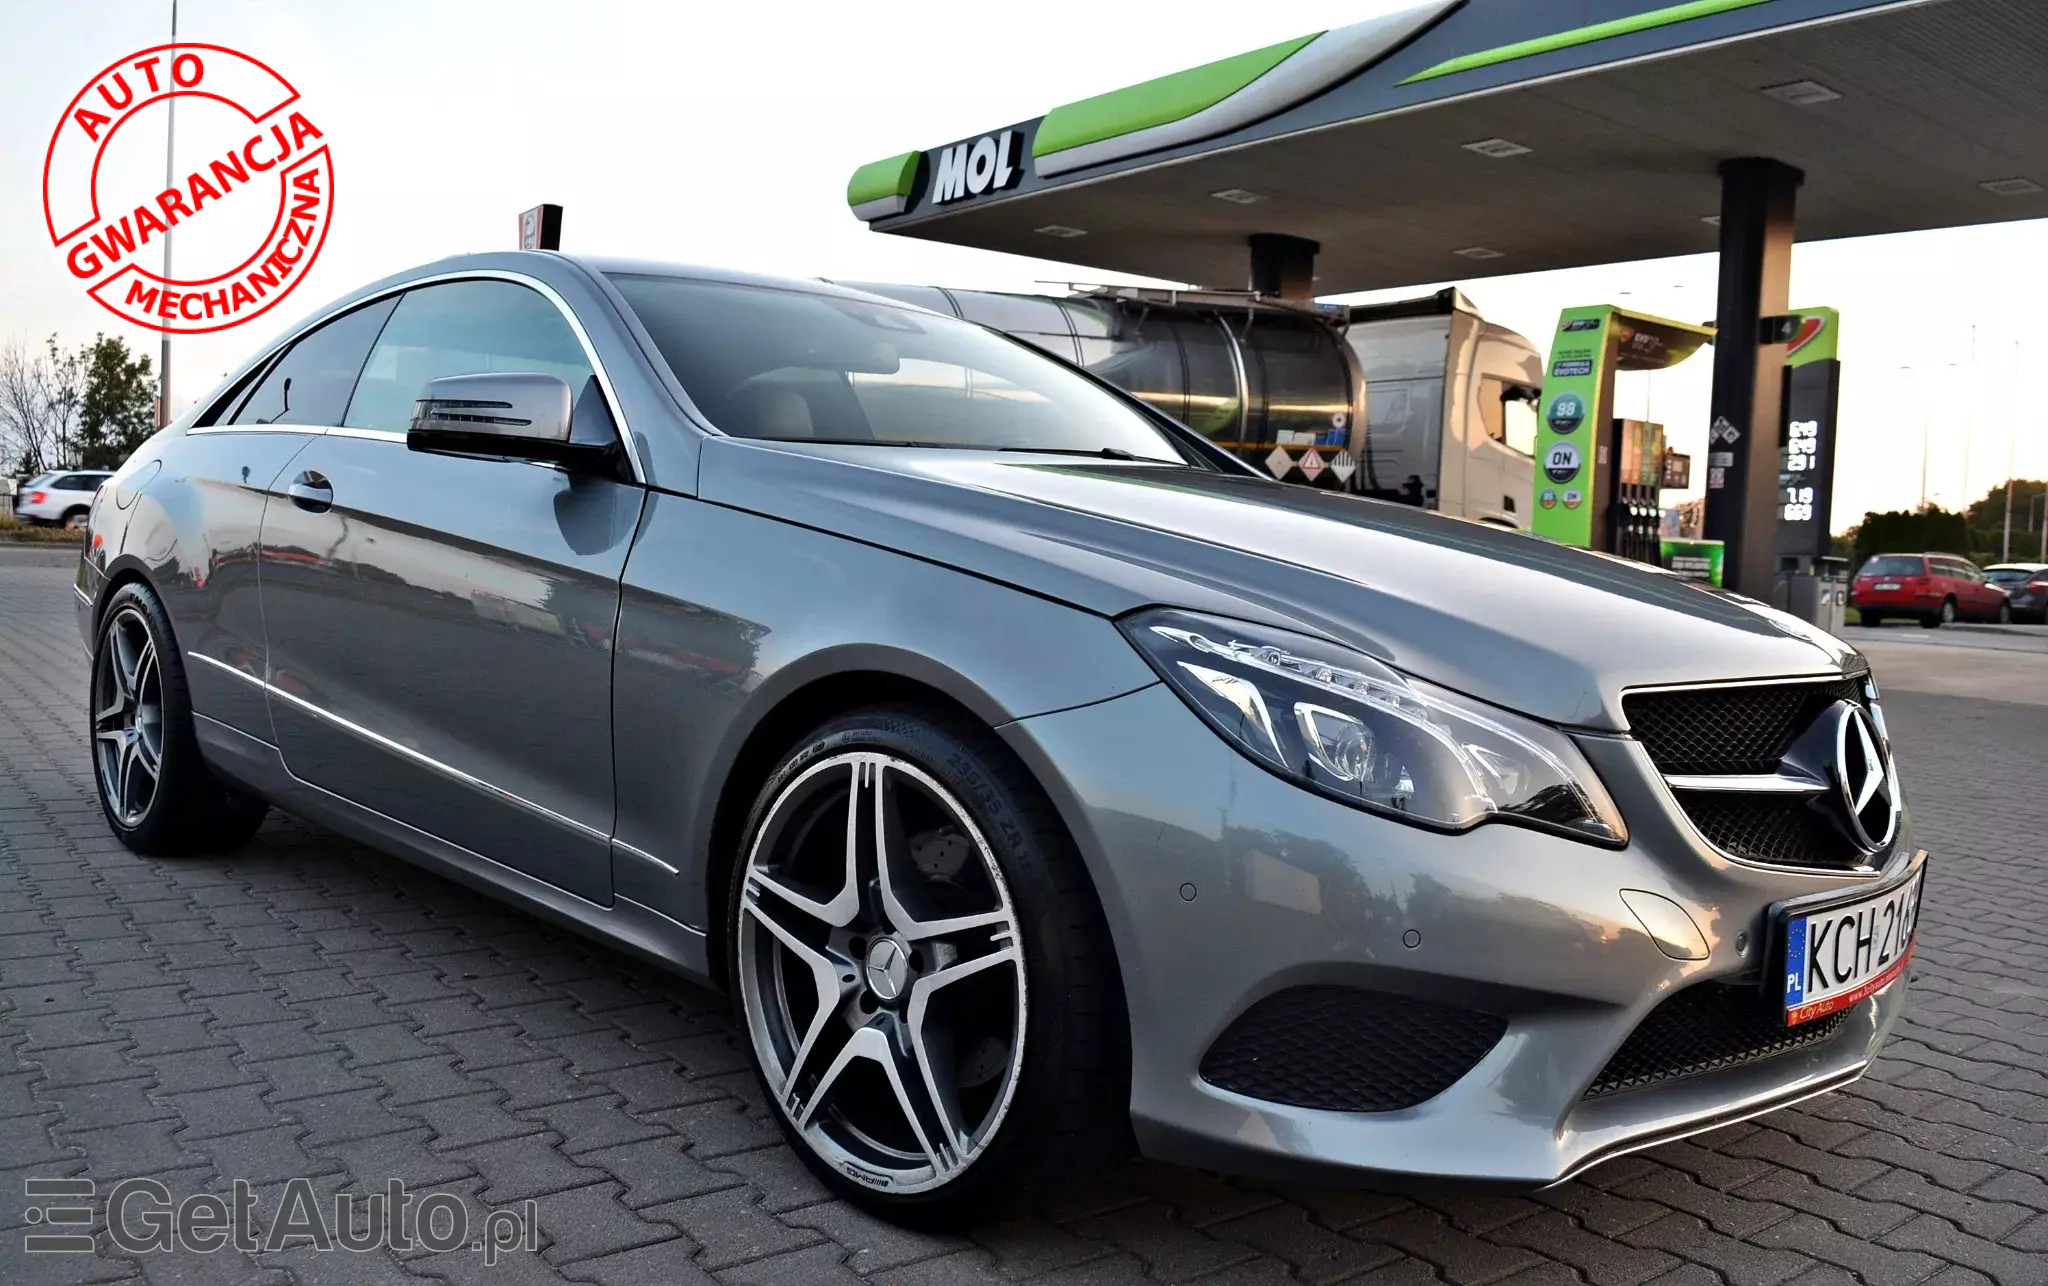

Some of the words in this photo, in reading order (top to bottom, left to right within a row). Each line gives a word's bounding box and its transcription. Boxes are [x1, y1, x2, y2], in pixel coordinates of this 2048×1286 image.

[932, 130, 1014, 204] MOL
[1781, 321, 1792, 335] 4
[1556, 402, 1576, 417] 98
[1807, 905, 1877, 993] KCH
[1786, 973, 1801, 994] PL
[1799, 1006, 1817, 1019] City
[1816, 1000, 1834, 1014] Auto
[846, 1166, 876, 1186] AMG
